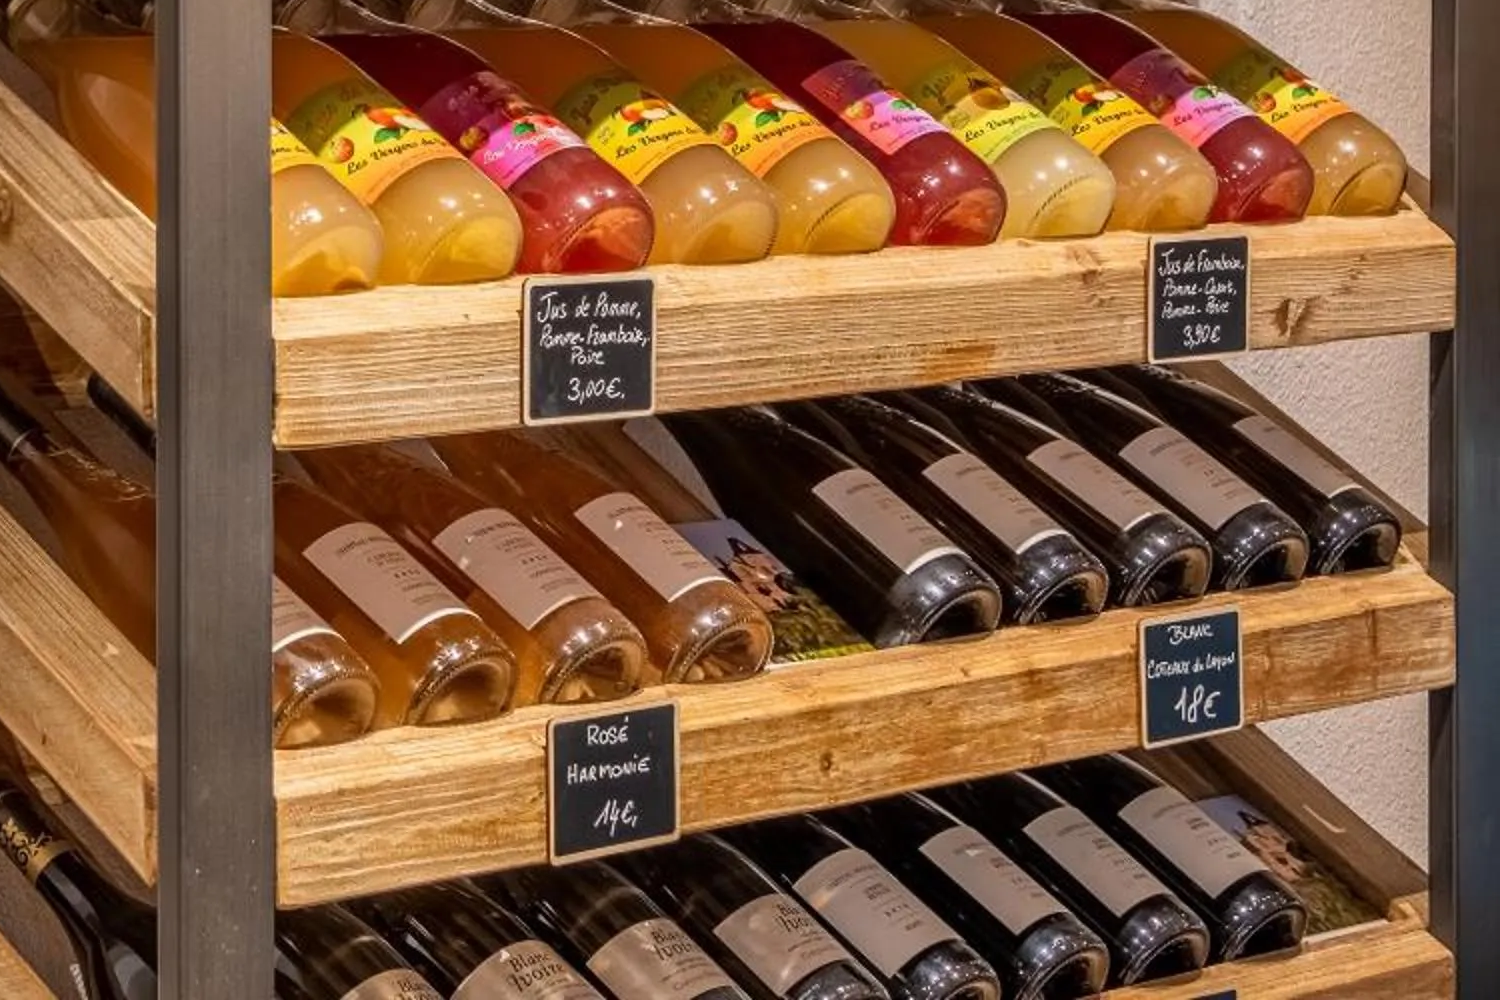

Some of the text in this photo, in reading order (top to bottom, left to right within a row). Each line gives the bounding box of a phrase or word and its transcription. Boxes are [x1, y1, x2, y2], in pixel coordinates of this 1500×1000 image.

[536, 291, 568, 323] Jus
[575, 295, 591, 318] de
[571, 345, 606, 366] Poire
[1174, 683, 1221, 723] 18€
